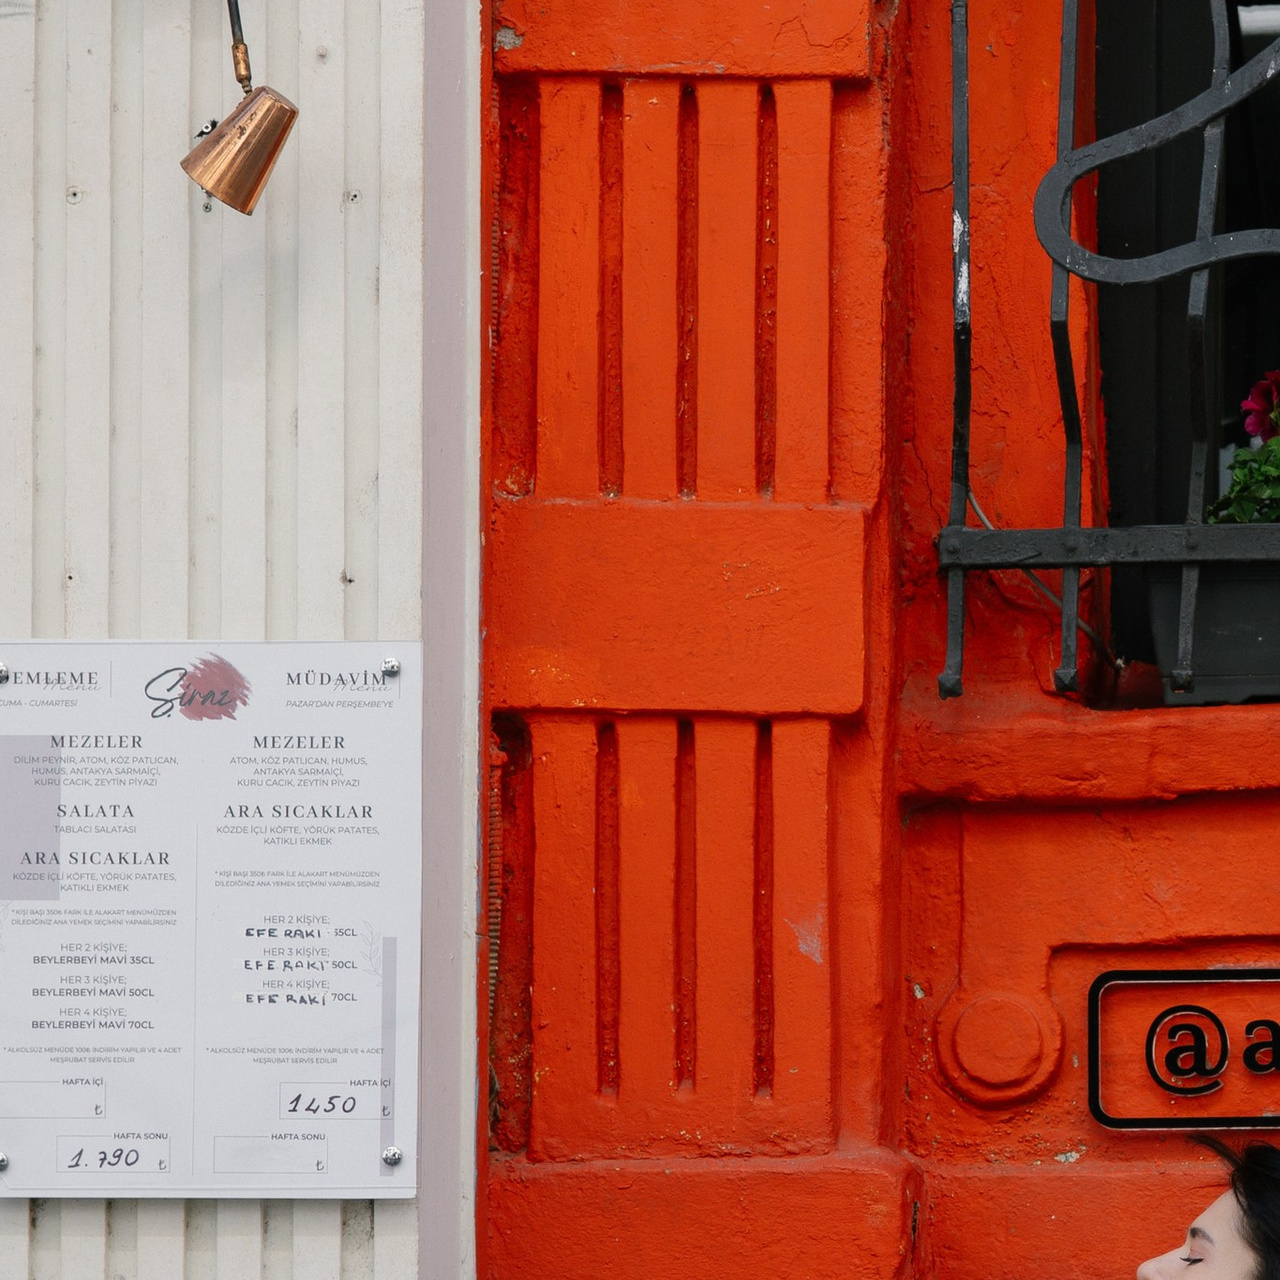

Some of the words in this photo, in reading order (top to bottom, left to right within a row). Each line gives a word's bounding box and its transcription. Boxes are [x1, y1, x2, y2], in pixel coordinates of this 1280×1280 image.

[12, 671, 98, 685] EMLEME
[286, 670, 387, 686] MÜDAVİM
[29, 698, 78, 707] CUMARTESİ
[50, 735, 143, 749] MEZELER
[253, 736, 346, 749] MEZELER
[14, 754, 40, 764] DİLİM
[42, 754, 77, 765] PEYNİR,
[79, 756, 108, 765] ATOM,
[110, 754, 130, 764] KÖZ
[230, 757, 259, 766] ATOM,
[261, 755, 281, 765] KÖZ
[331, 757, 368, 766] HUMUS,
[31, 767, 69, 776] HUMUS,
[70, 767, 113, 775] ANTAKYA
[253, 768, 296, 776] ANTAKYA
[62, 779, 93, 788] CACIK,
[94, 777, 126, 786] ZEYTİN
[237, 779, 264, 787] KURU
[265, 779, 295, 788] CACIK,
[297, 777, 329, 787] ZEYTİN
[57, 804, 135, 818] SALATA
[223, 805, 264, 818] ARA
[271, 805, 373, 818] SICAKLAR
[216, 825, 248, 834] KÖZDE
[269, 825, 301, 835] KÖFTE,
[304, 825, 336, 834] YÖRÜK
[338, 827, 380, 835] PATATES,
[20, 851, 60, 865] ARA
[69, 851, 170, 865] SICAKLAR
[12, 871, 45, 881] KÖZDE
[66, 871, 98, 882] KÖFTE,
[100, 871, 133, 881] YÖRÜK
[135, 873, 177, 882] PATATES,
[96, 884, 129, 892] EKMEK
[264, 916, 285, 924] HER
[288, 916, 294, 924] 2
[245, 928, 278, 938] EFE
[61, 943, 82, 951] HER
[85, 943, 91, 951] 2
[264, 948, 285, 956] HER
[288, 948, 294, 956] 3
[33, 955, 97, 964] BEYLERBEYİ
[100, 955, 127, 964] MAVİ
[130, 956, 155, 964] 35CL
[244, 960, 276, 970] EFE
[332, 960, 357, 969] 50CL
[60, 976, 82, 984] HER
[84, 976, 90, 984] 3
[263, 980, 285, 988] HER
[287, 980, 294, 988] 4
[32, 987, 96, 996] BEYLERBEYİ
[99, 987, 126, 996] MAVİ
[129, 988, 155, 997] 50CL
[246, 994, 279, 1004] EFE
[331, 992, 357, 1001] 70CL
[59, 1008, 81, 1016] HER
[83, 1008, 90, 1016] 4
[31, 1020, 96, 1029] BEYLERBEYİ
[99, 1020, 126, 1029] MAVİ
[128, 1021, 155, 1029] 70CL
[92, 1077, 104, 1088] İÇİ
[380, 1078, 391, 1088] İÇİ
[288, 1093, 356, 1114] 1450
